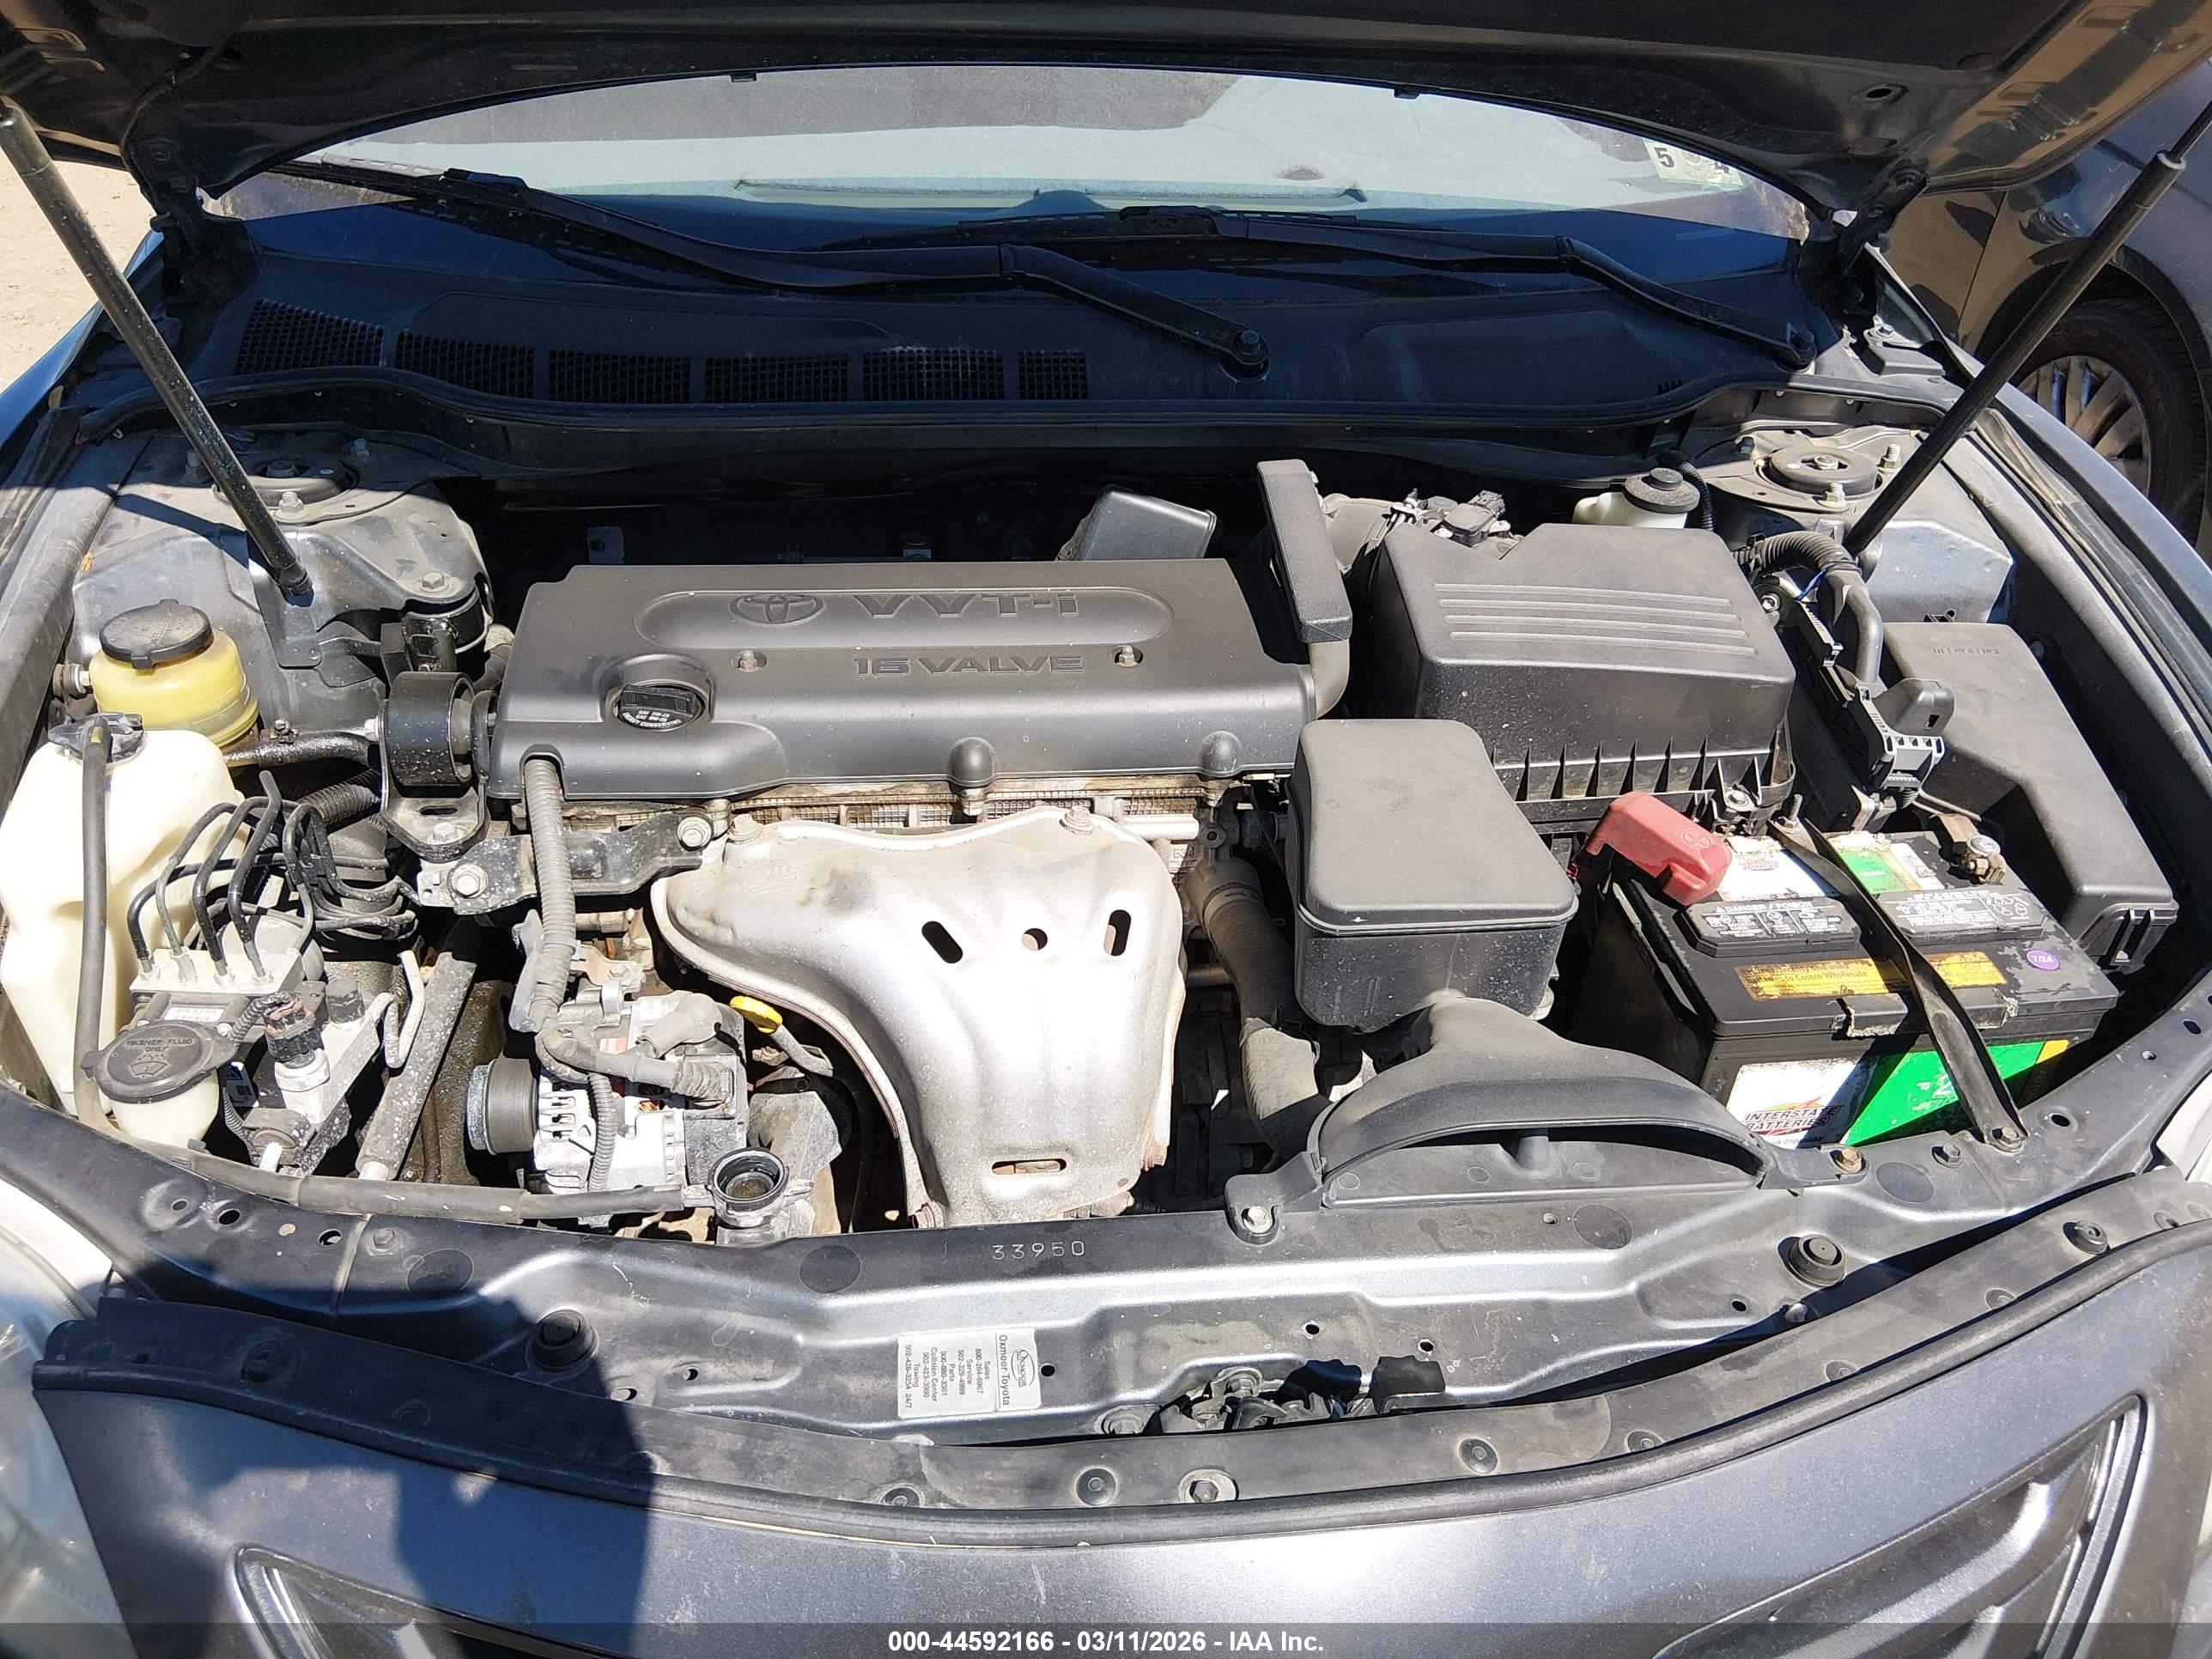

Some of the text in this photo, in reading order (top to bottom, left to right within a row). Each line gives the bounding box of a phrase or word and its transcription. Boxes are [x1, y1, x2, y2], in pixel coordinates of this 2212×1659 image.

[852, 594, 1079, 617] VVT-i
[854, 655, 1085, 677] 16 VALVE
[1745, 1105, 1842, 1121] INTERSTATE
[1746, 1116, 1830, 1131] BATTERIES
[992, 1241, 1086, 1260] 33950
[930, 1346, 939, 1376] Collision
[966, 1358, 975, 1385] Service
[999, 1334, 1011, 1406] Oxmoor Toyota
[912, 1363, 921, 1388] Towing
